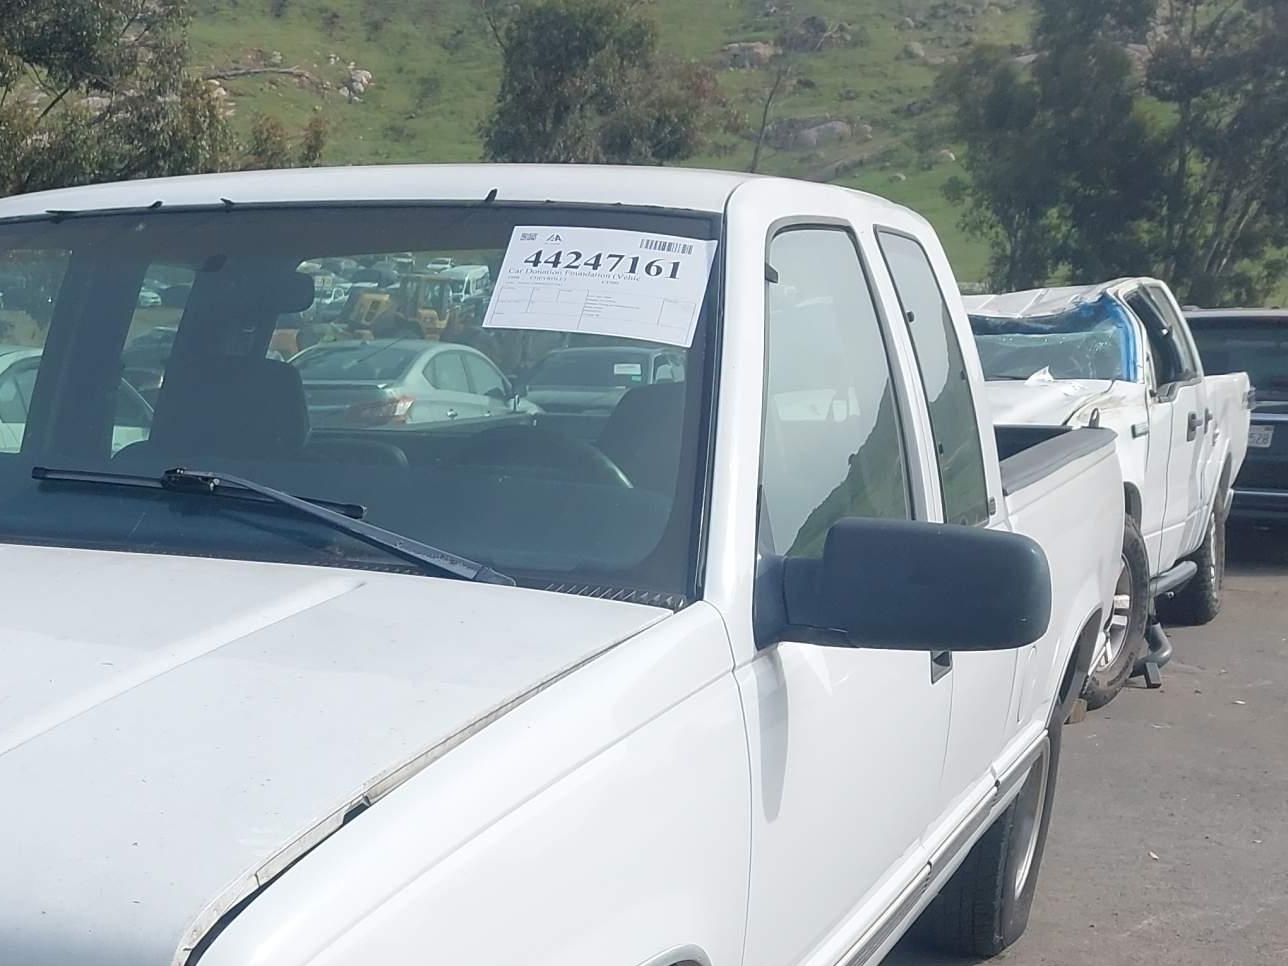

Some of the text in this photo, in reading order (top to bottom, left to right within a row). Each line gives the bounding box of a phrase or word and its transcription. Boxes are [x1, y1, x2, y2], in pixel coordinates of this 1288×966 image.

[508, 267, 523, 275] Car
[525, 268, 562, 276] Donation
[564, 270, 611, 279] Foundation
[523, 249, 681, 280] 44247161
